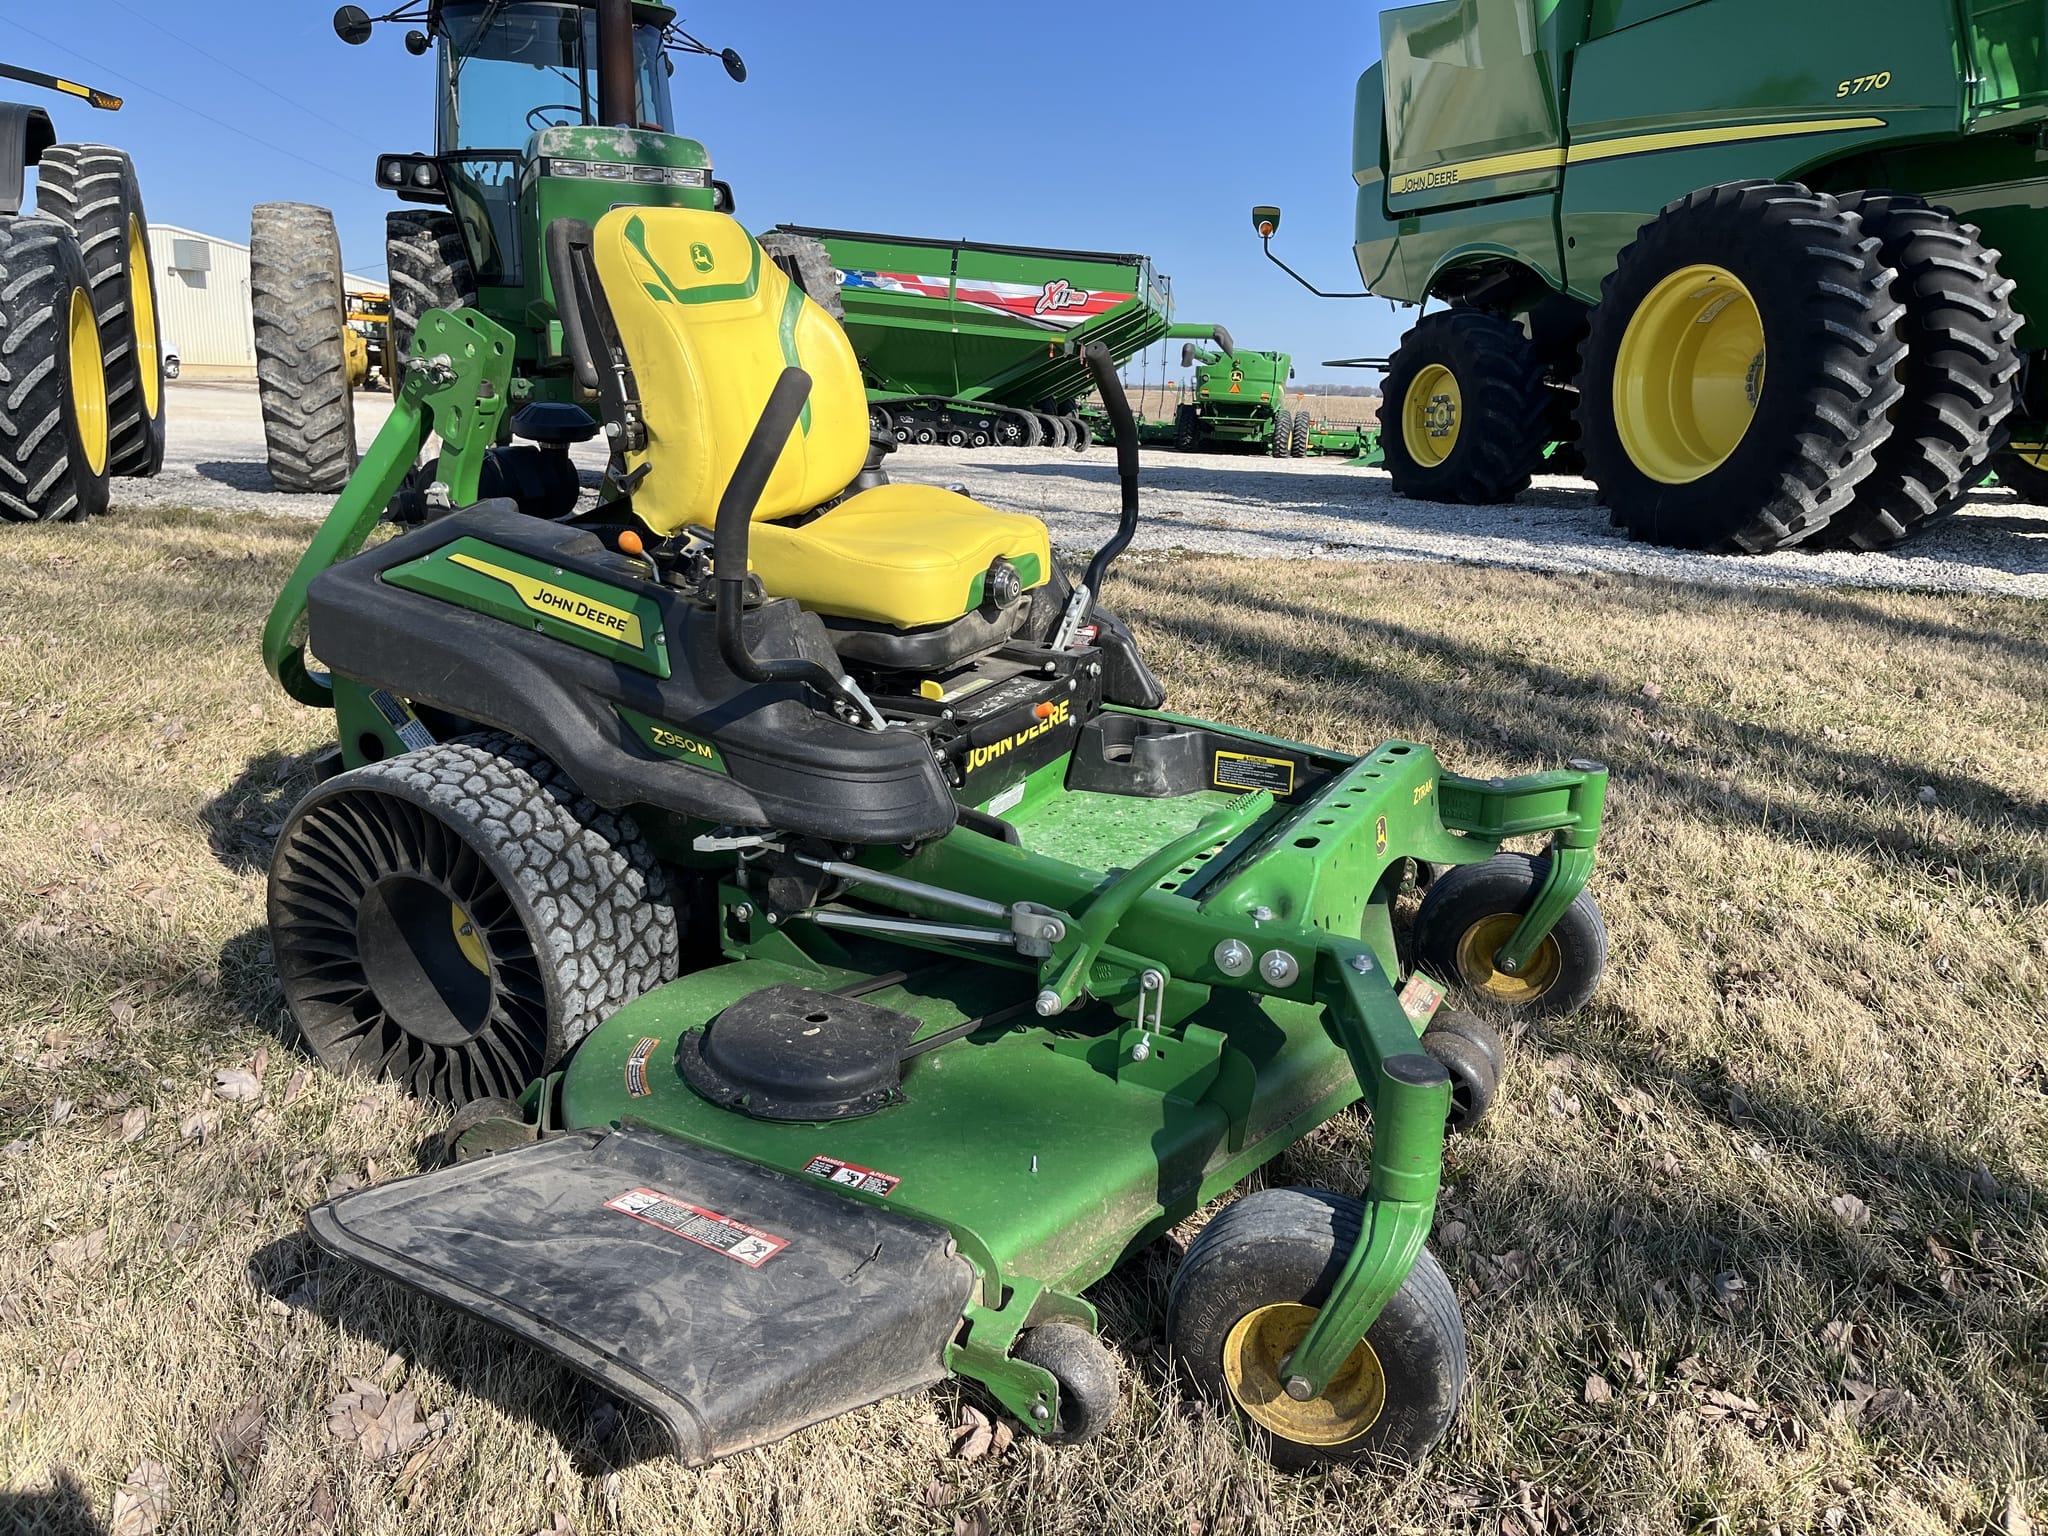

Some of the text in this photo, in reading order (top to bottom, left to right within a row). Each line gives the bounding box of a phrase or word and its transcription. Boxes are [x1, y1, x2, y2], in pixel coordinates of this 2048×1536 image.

[1836, 71, 1891, 98] S770
[1400, 169, 1459, 193] JOHN DEERE
[533, 588, 628, 632] JOHN DEERE
[650, 726, 713, 759] Z950M
[729, 1220, 768, 1239] PELIGRO
[1190, 1277, 1266, 1358] CARLIS
